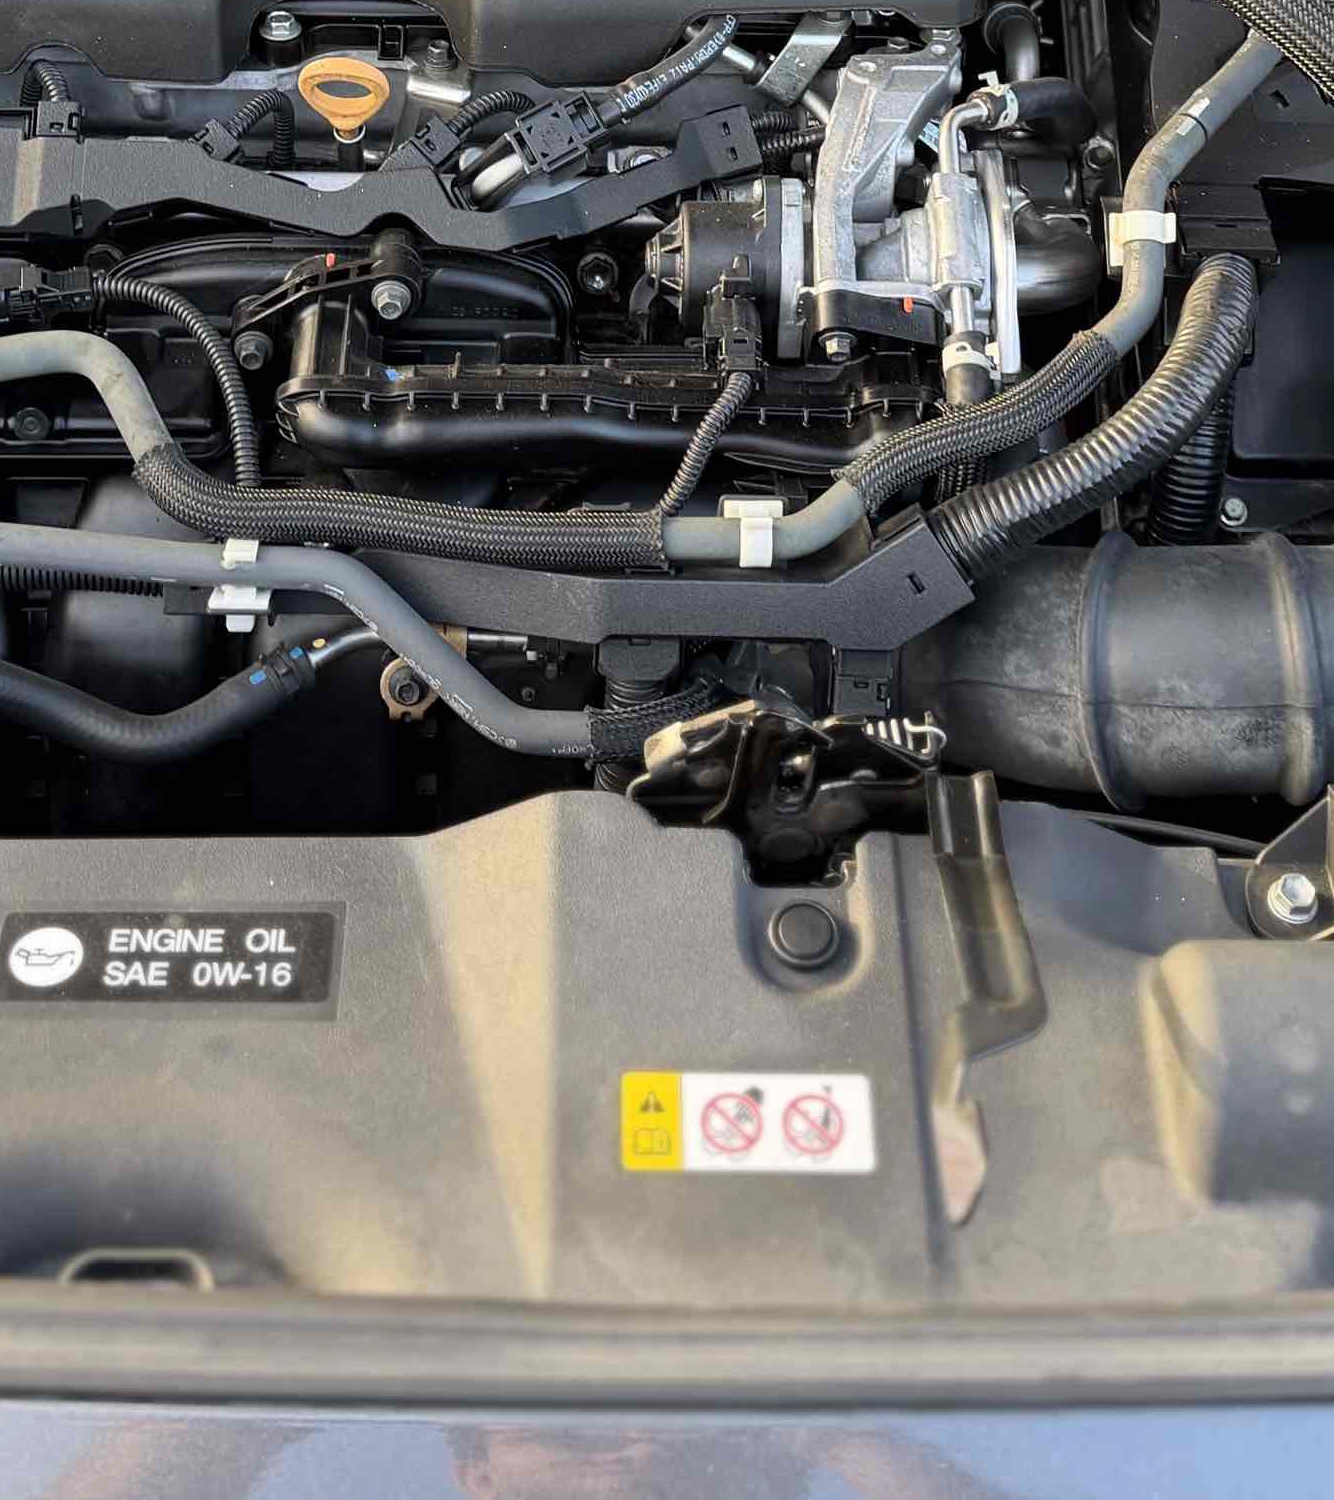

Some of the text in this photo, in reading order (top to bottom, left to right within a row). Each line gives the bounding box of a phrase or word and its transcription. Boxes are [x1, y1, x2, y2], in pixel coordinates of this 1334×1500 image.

[108, 928, 296, 954] ENGINE OIL
[102, 961, 293, 987] SAE 0W-16
